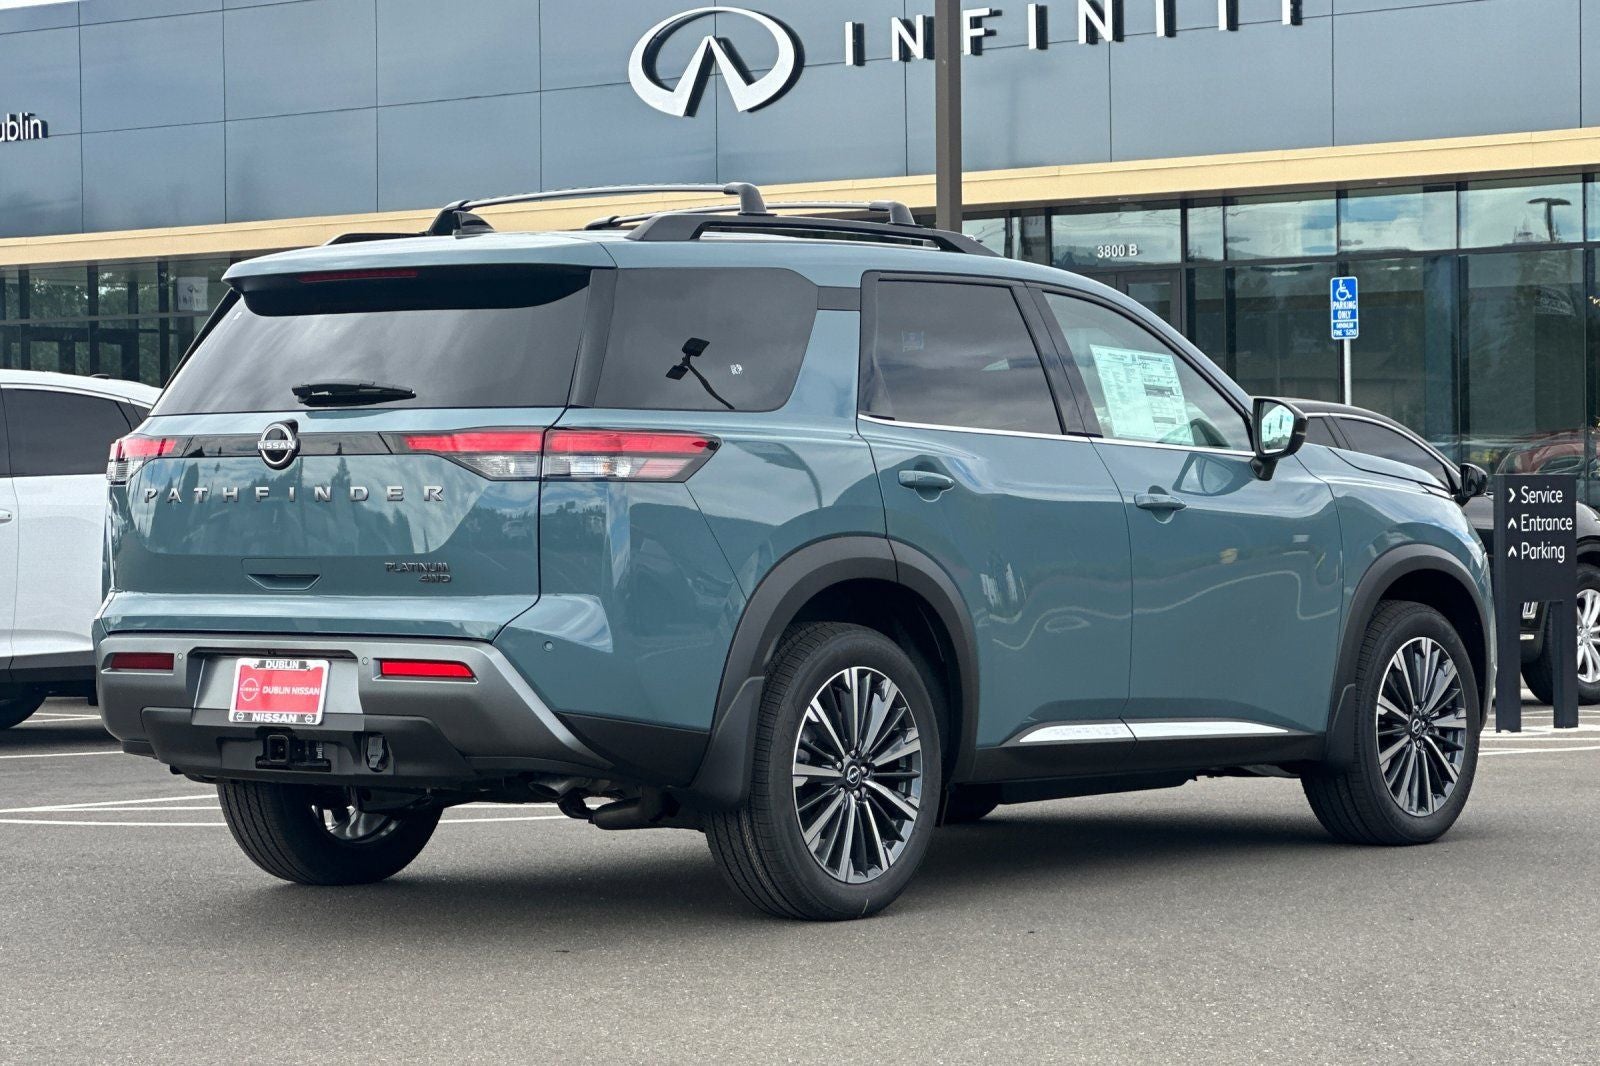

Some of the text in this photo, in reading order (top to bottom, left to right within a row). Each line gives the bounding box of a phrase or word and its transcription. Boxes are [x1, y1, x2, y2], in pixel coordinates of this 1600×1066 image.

[1097, 243, 1138, 258] 3800 B
[1333, 301, 1356, 309] PARKING
[1337, 311, 1351, 319] ONLY
[257, 440, 296, 450] NISSAN
[144, 485, 446, 504] PATHFINDER
[1520, 485, 1563, 504] Service
[1521, 513, 1573, 532] Entrance
[1521, 541, 1565, 564] Parking
[384, 562, 451, 573] PLATINUM
[418, 573, 452, 583] 4WD
[265, 660, 299, 669] DUBLIN
[262, 686, 320, 696] DUBLIN NISSAN
[251, 712, 298, 723] NISSAN
